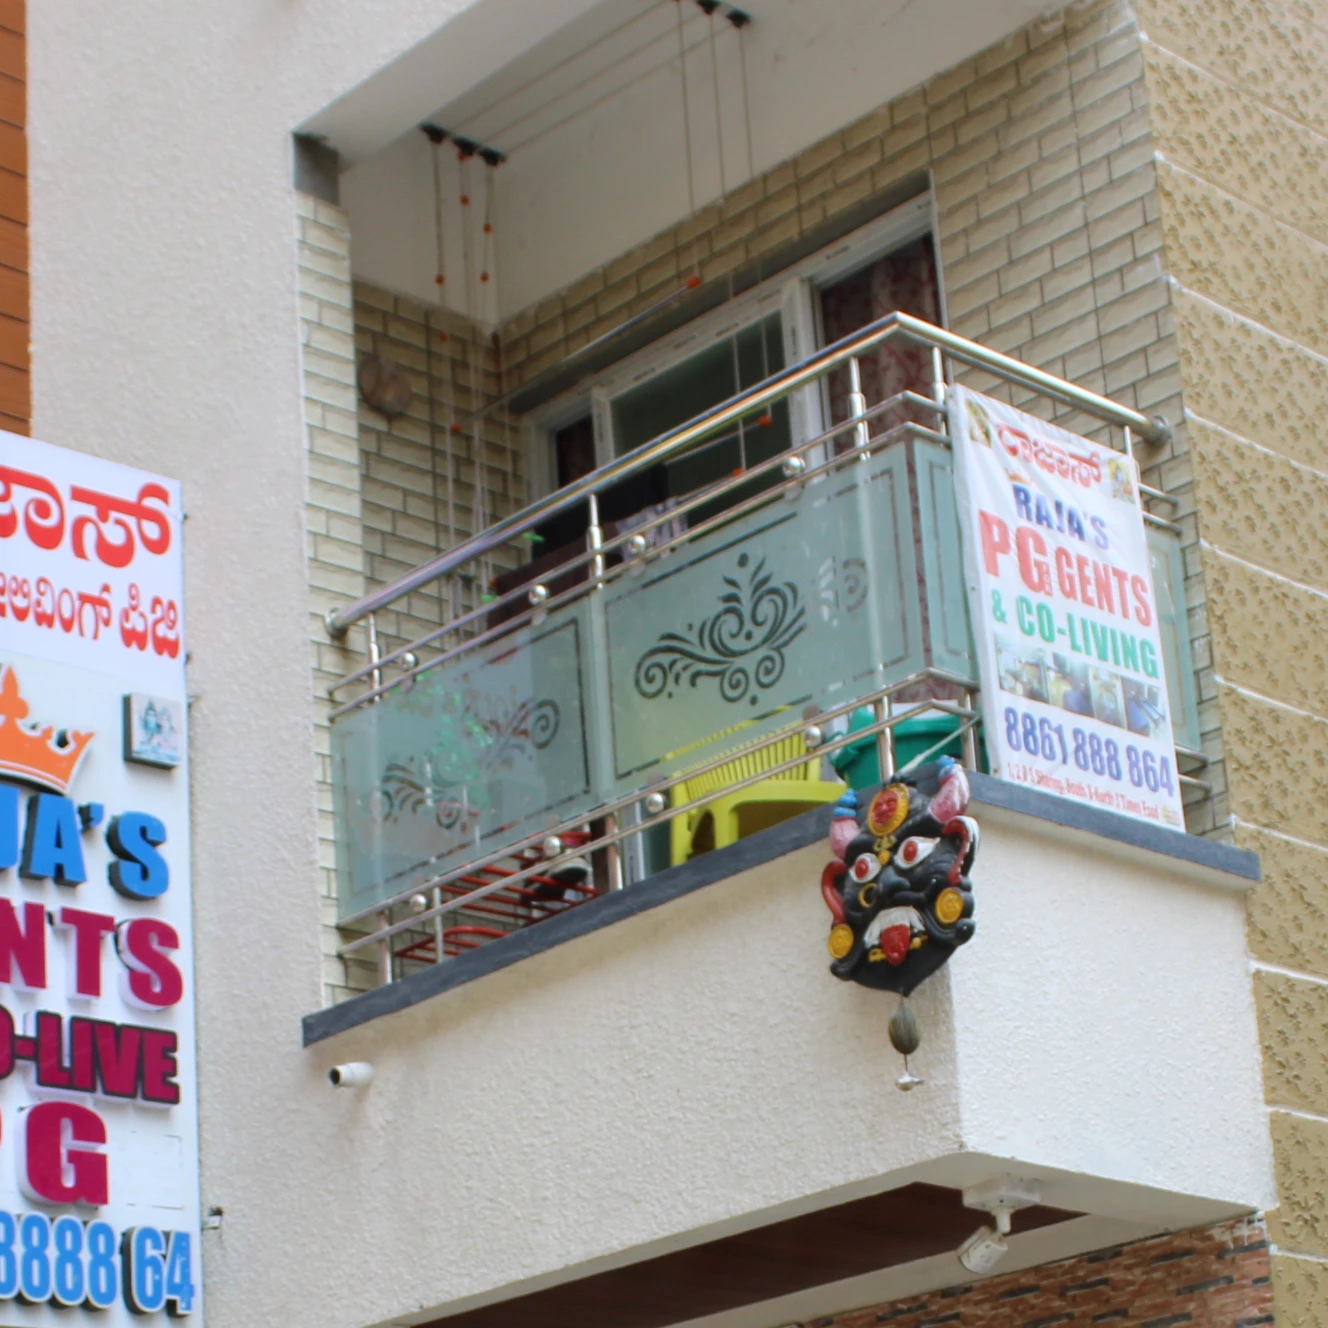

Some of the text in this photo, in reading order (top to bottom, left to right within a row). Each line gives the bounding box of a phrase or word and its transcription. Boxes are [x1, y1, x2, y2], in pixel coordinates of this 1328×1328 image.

[1012, 483, 1109, 550] RAJA'S
[978, 508, 1053, 597] PG
[1055, 546, 1153, 627] GENTS
[991, 588, 1159, 680] & CO-LIVING
[1005, 706, 1174, 797] 8861 888 864
